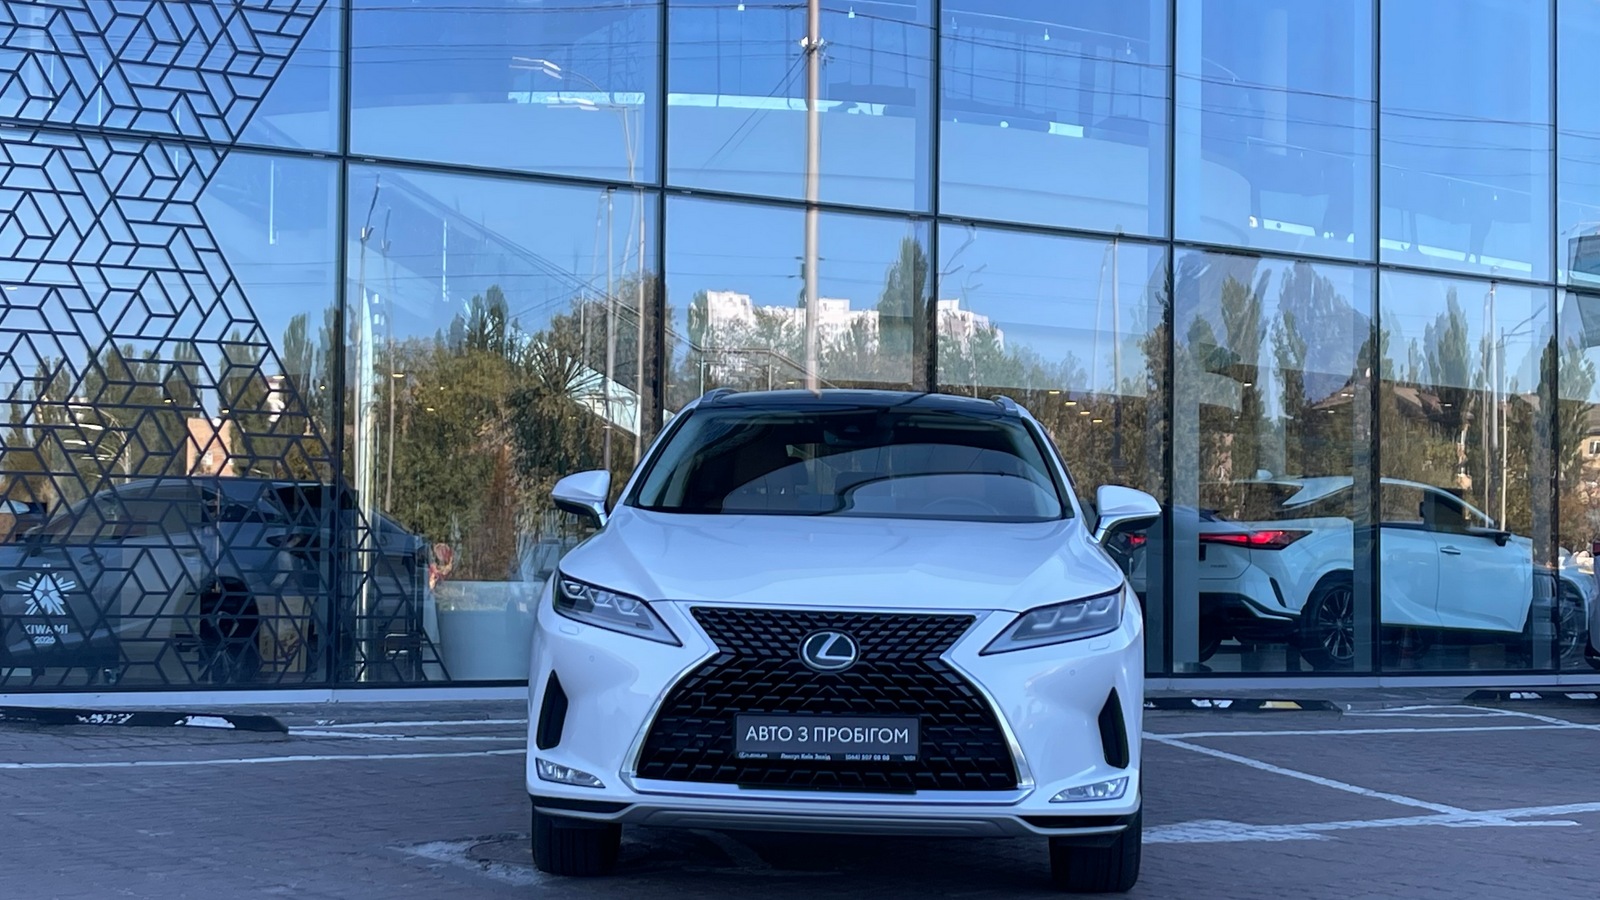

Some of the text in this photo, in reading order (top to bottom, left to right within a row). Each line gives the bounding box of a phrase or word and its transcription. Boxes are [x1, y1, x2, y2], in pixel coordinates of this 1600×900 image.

[24, 624, 69, 634] KIWAMI
[745, 726, 793, 741] АВТО
[814, 727, 909, 744] ПРОБІГОМ
